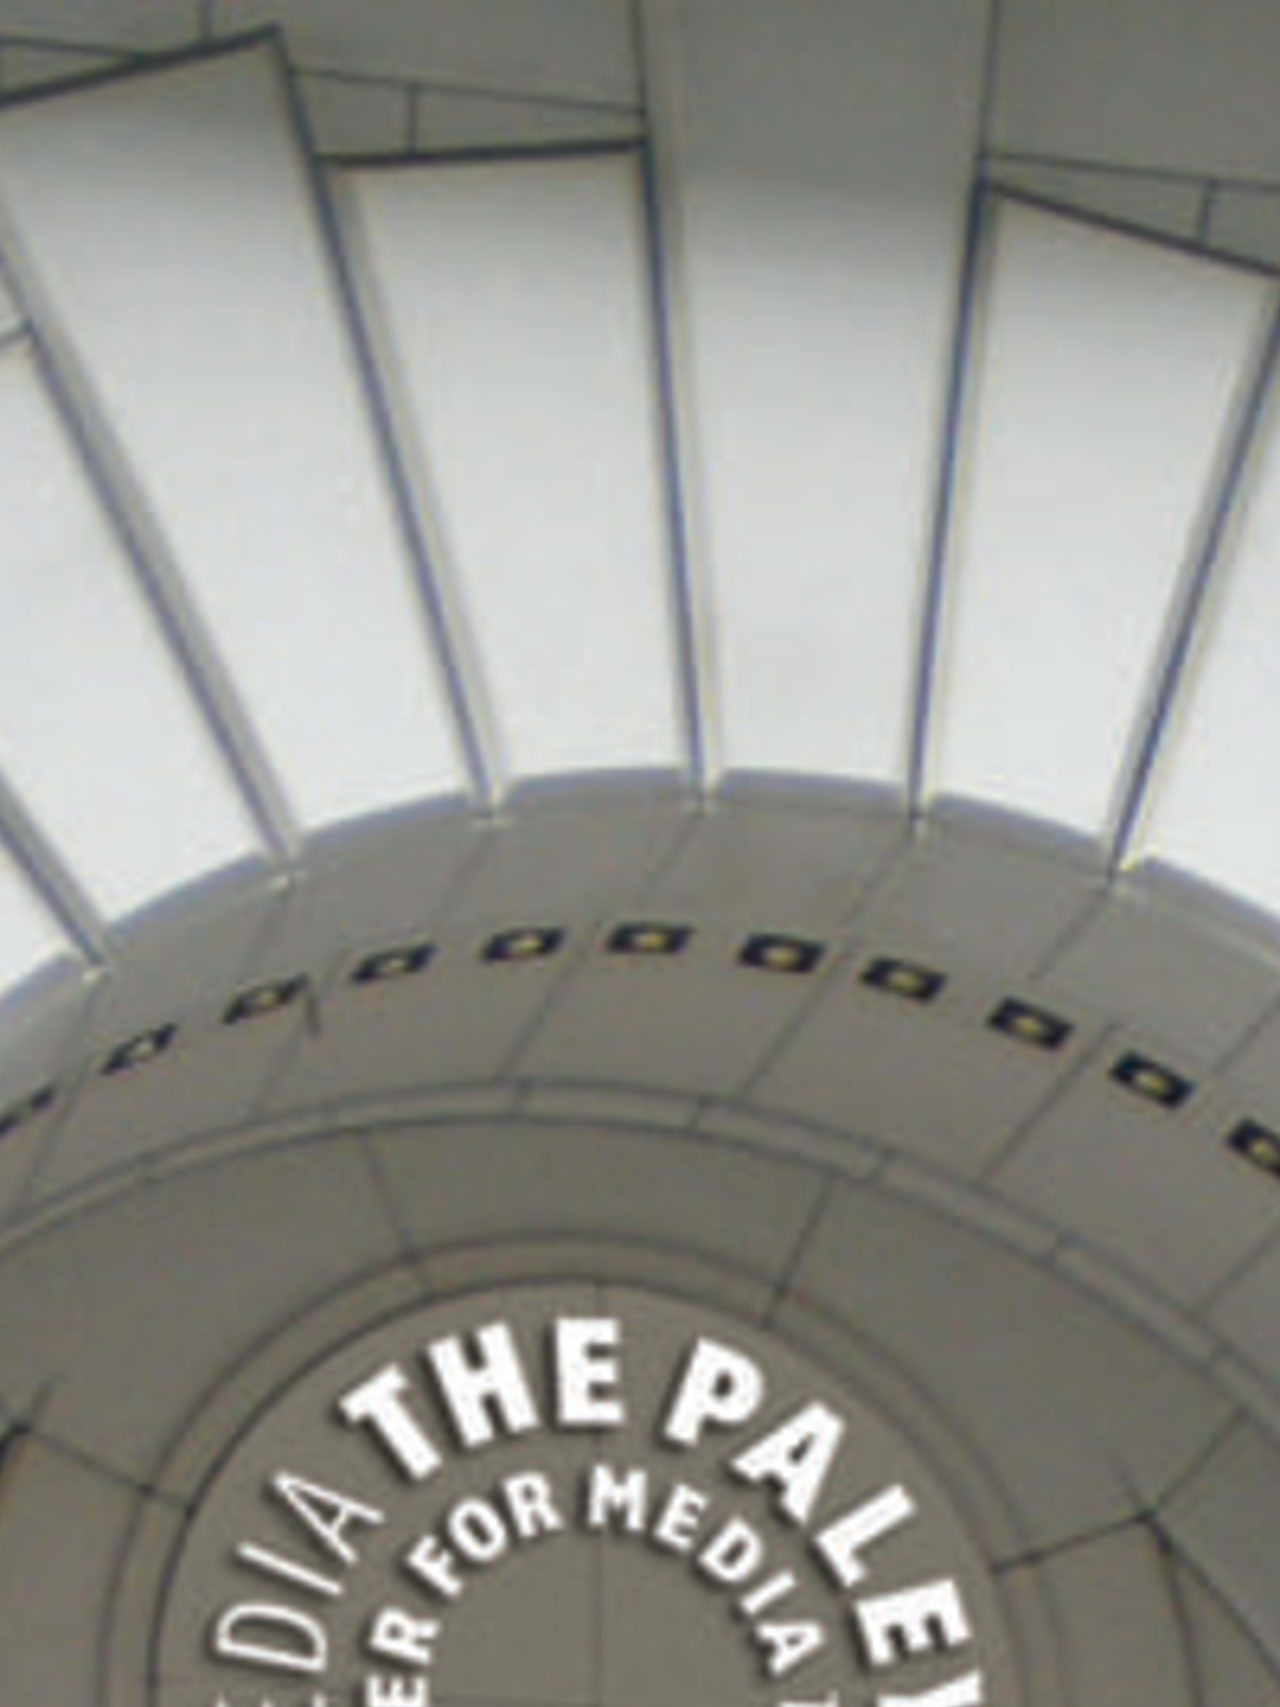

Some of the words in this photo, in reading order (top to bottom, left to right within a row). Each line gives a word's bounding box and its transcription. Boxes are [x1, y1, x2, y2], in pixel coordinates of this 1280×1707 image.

[339, 1317, 624, 1480] THE
[407, 1471, 560, 1596] FOR
[588, 1465, 827, 1675] MEDIA
